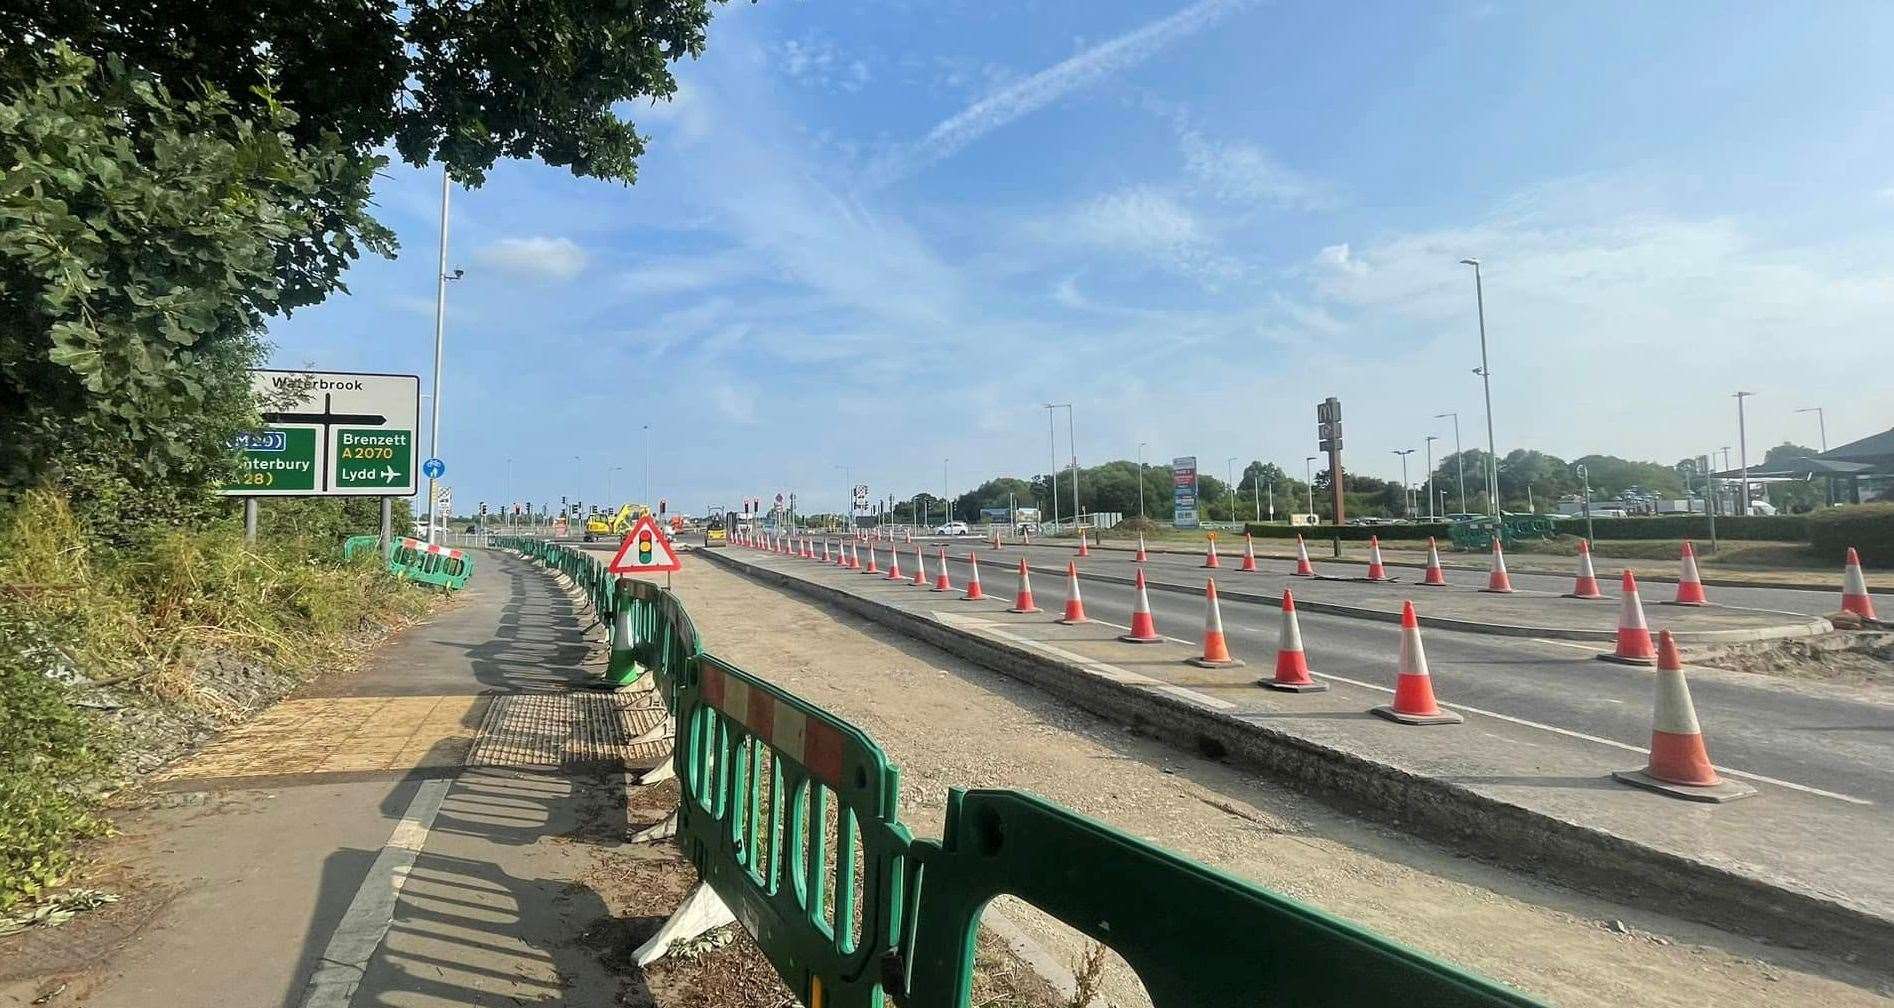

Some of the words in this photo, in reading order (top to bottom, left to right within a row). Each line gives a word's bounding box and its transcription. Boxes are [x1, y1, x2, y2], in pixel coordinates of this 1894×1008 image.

[272, 377, 362, 390] Waterbrook
[343, 433, 406, 446] Brenzett
[243, 458, 310, 472] nterbury
[342, 468, 376, 482] Lydd
